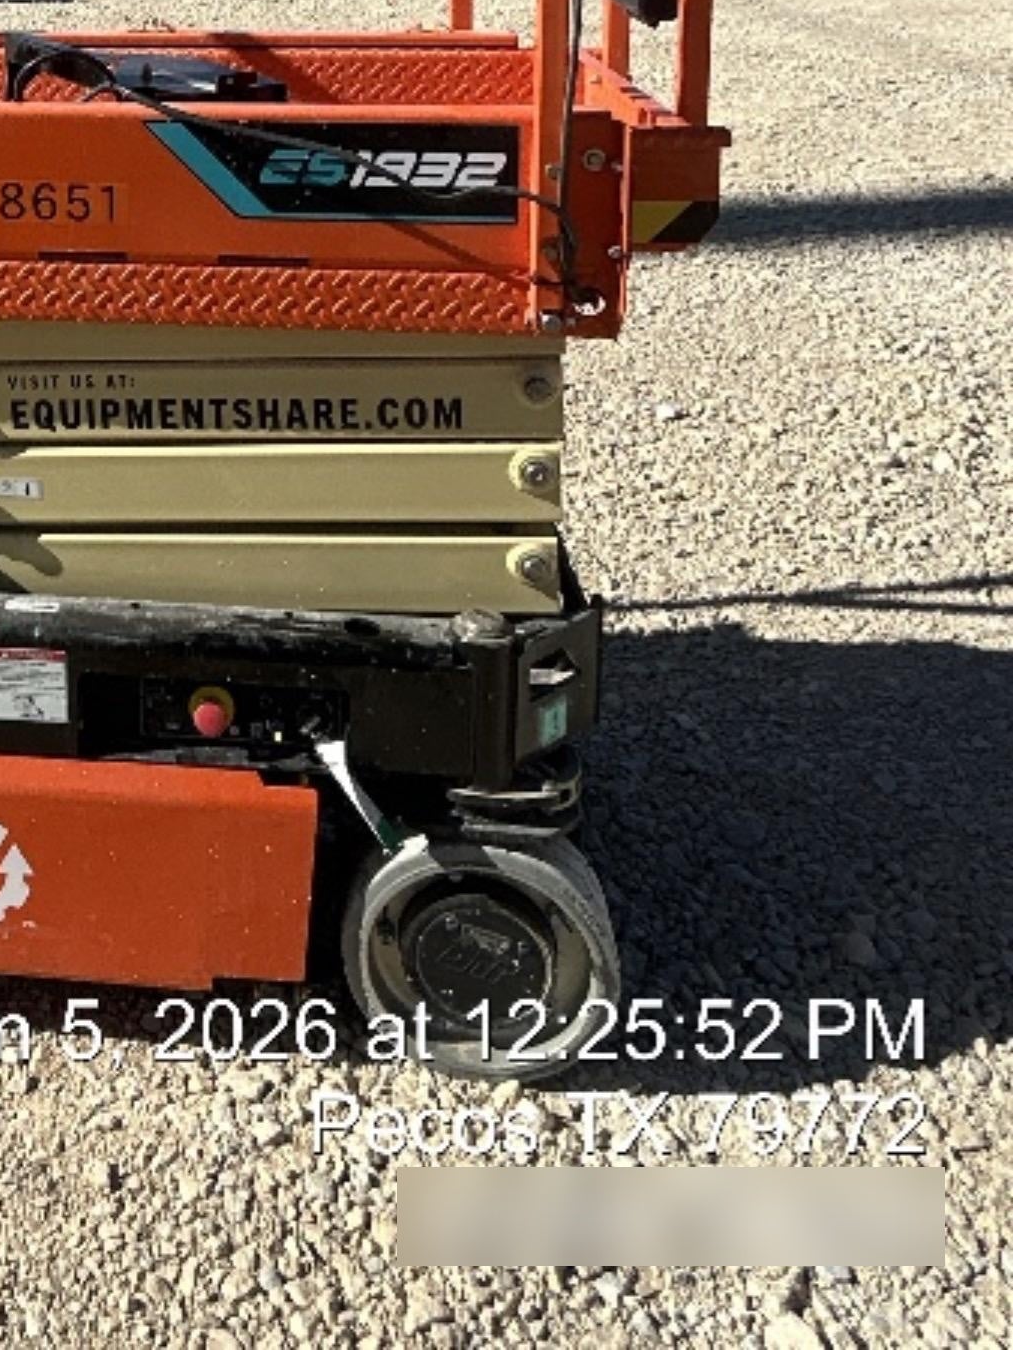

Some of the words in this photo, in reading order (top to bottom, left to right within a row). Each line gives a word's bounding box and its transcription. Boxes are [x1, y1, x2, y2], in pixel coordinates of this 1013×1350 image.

[259, 149, 507, 188] ES1932
[7, 374, 60, 390] VISIT
[69, 374, 95, 389] US
[105, 374, 135, 388] AT:
[10, 396, 463, 433] EQUIPMENTSHARE.COM
